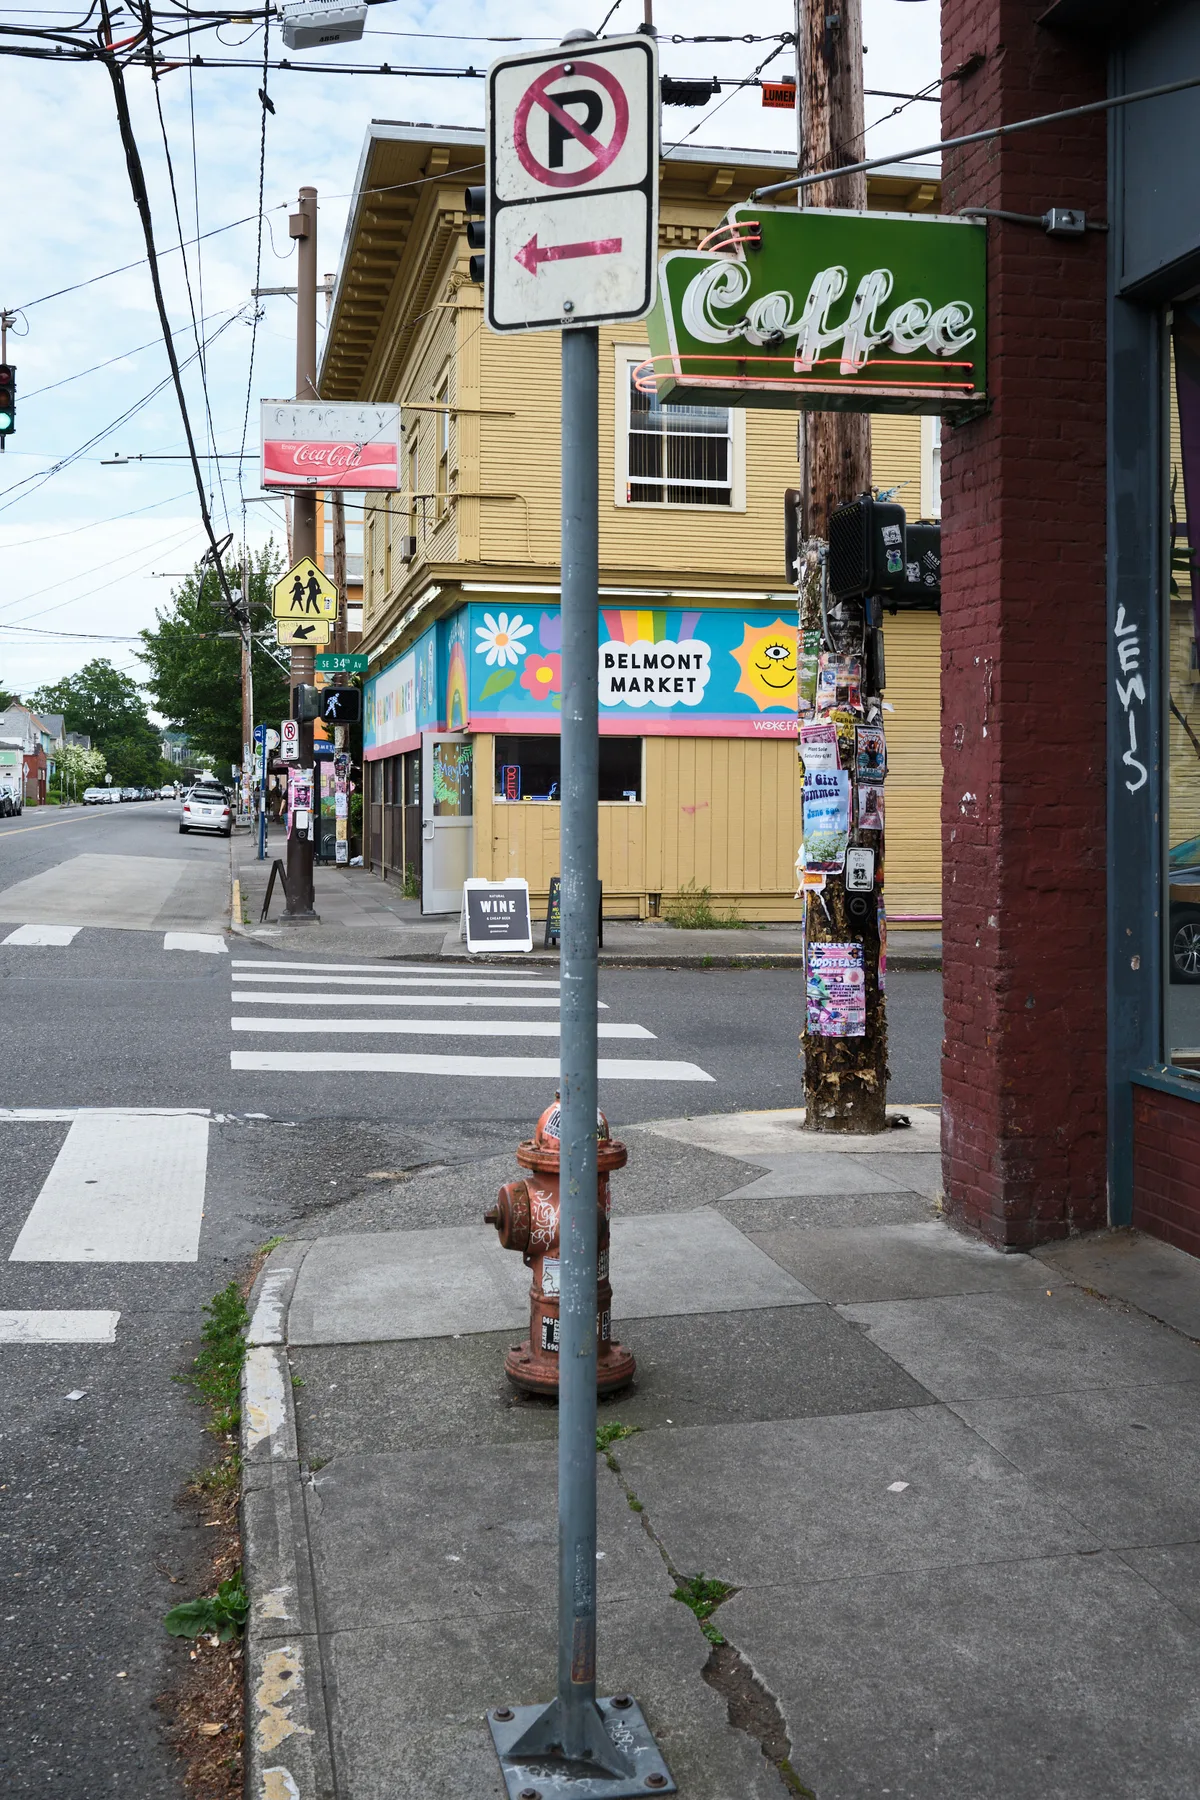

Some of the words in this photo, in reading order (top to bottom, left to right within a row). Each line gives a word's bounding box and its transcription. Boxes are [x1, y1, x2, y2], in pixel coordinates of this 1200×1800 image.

[763, 89, 796, 102] LUMEN
[682, 259, 977, 376] Coffee
[281, 443, 297, 451] Enjoy
[322, 660, 329, 668] SE
[604, 653, 703, 670] BELMONT
[610, 676, 697, 693] MARKET
[1114, 602, 1148, 793] LEWIS
[753, 720, 799, 731] WOKEFA
[506, 765, 517, 800] OPEN
[815, 773, 839, 786] Girl
[480, 900, 516, 913] WINE
